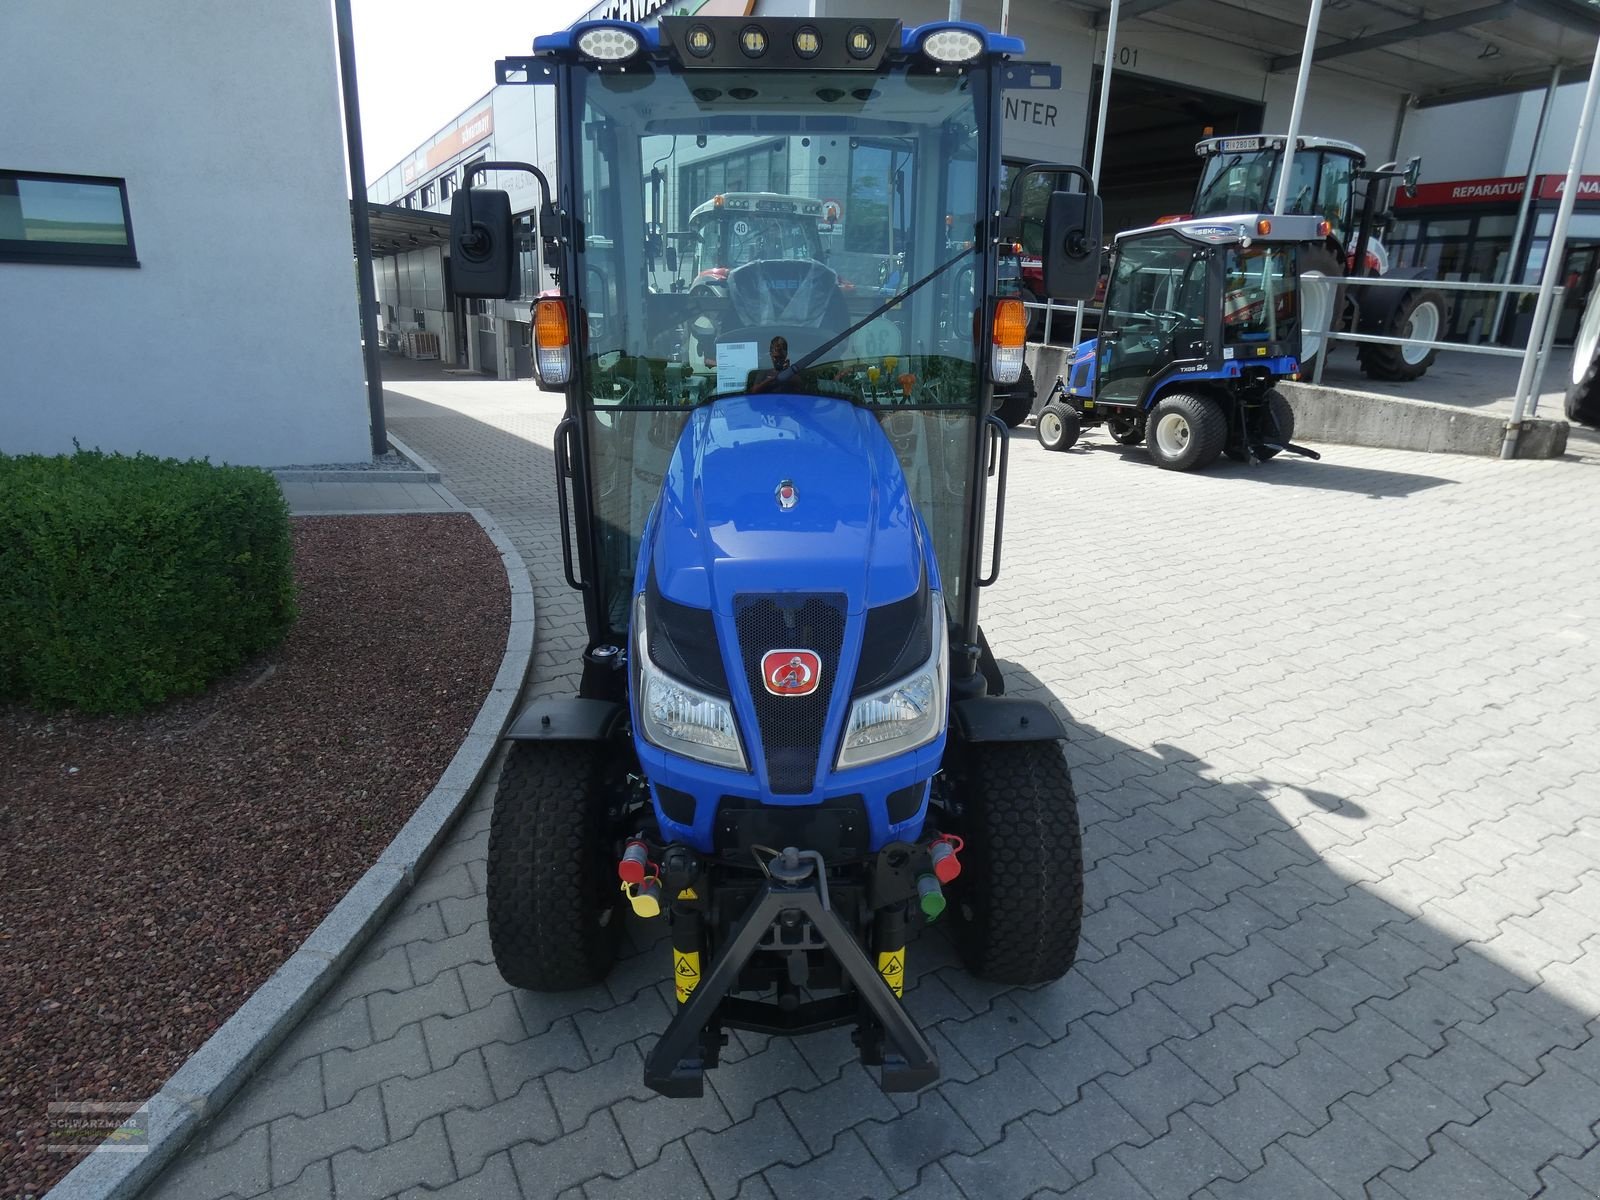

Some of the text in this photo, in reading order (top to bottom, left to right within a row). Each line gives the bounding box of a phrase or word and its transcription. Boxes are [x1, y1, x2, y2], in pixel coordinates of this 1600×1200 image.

[1120, 46, 1138, 67] 01
[1003, 97, 1058, 127] NTER
[1555, 180, 1600, 193] ANA
[736, 223, 746, 233] 40
[1196, 364, 1208, 372] 24
